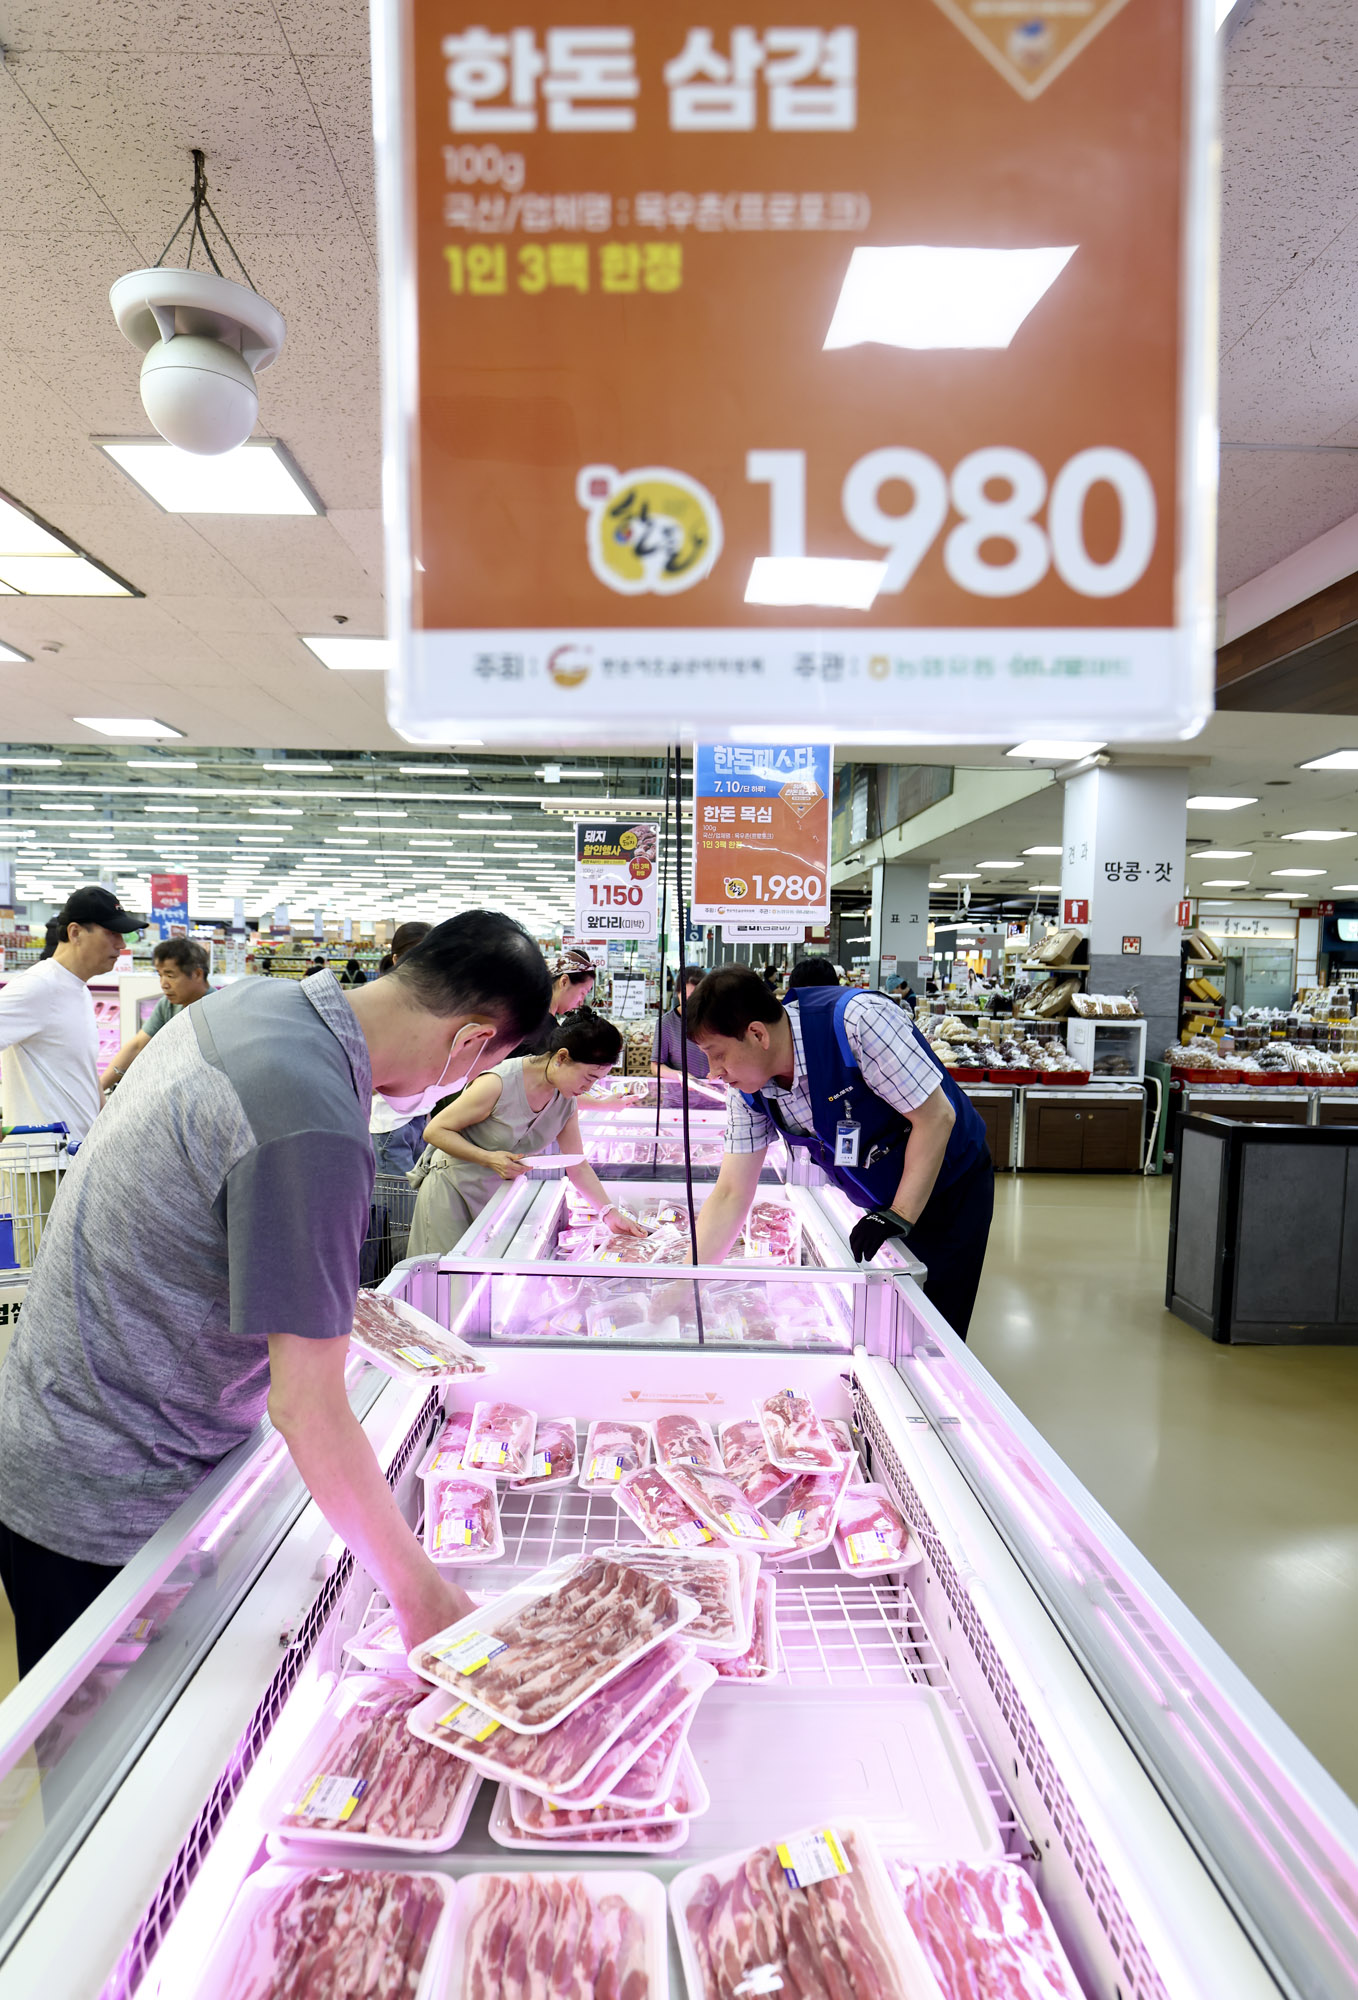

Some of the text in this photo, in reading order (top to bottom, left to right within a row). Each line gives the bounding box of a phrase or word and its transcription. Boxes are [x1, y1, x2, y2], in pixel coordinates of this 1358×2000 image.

[442, 25, 859, 133] 한돈 삼겹
[443, 144, 525, 191] 100g
[444, 242, 682, 294] 1인 3팩 한정
[703, 806, 773, 824] 한돈 목심
[584, 830, 607, 843] 돼지
[702, 841, 713, 849] 1인
[714, 841, 727, 849] 3팩
[583, 845, 621, 857] 할인행사
[589, 884, 644, 907] 1,150
[752, 875, 822, 902] 1,980
[587, 915, 645, 929] 앞다리(미박)
